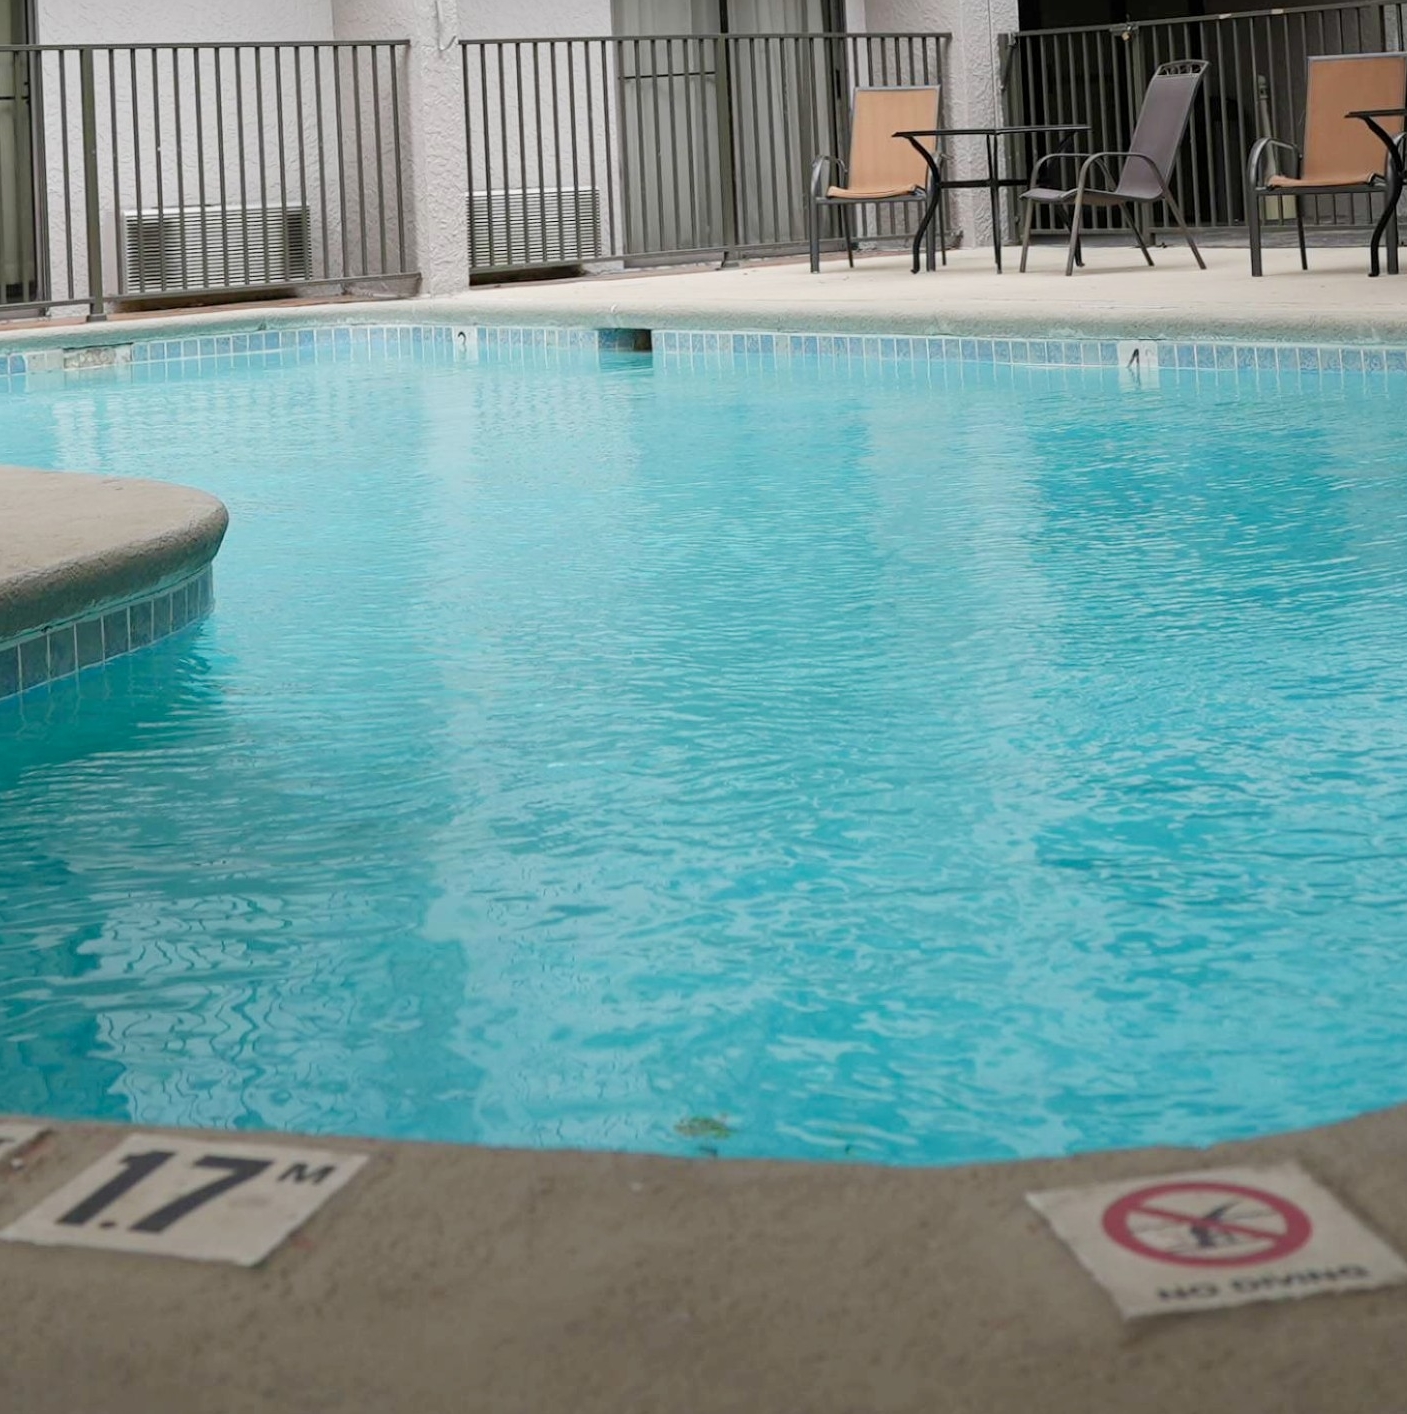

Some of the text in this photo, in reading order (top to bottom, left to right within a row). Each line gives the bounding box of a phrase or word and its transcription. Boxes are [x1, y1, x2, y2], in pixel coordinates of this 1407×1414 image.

[55, 1151, 338, 1234] 1.7 M
[1158, 1265, 1370, 1300] NO DIVING
